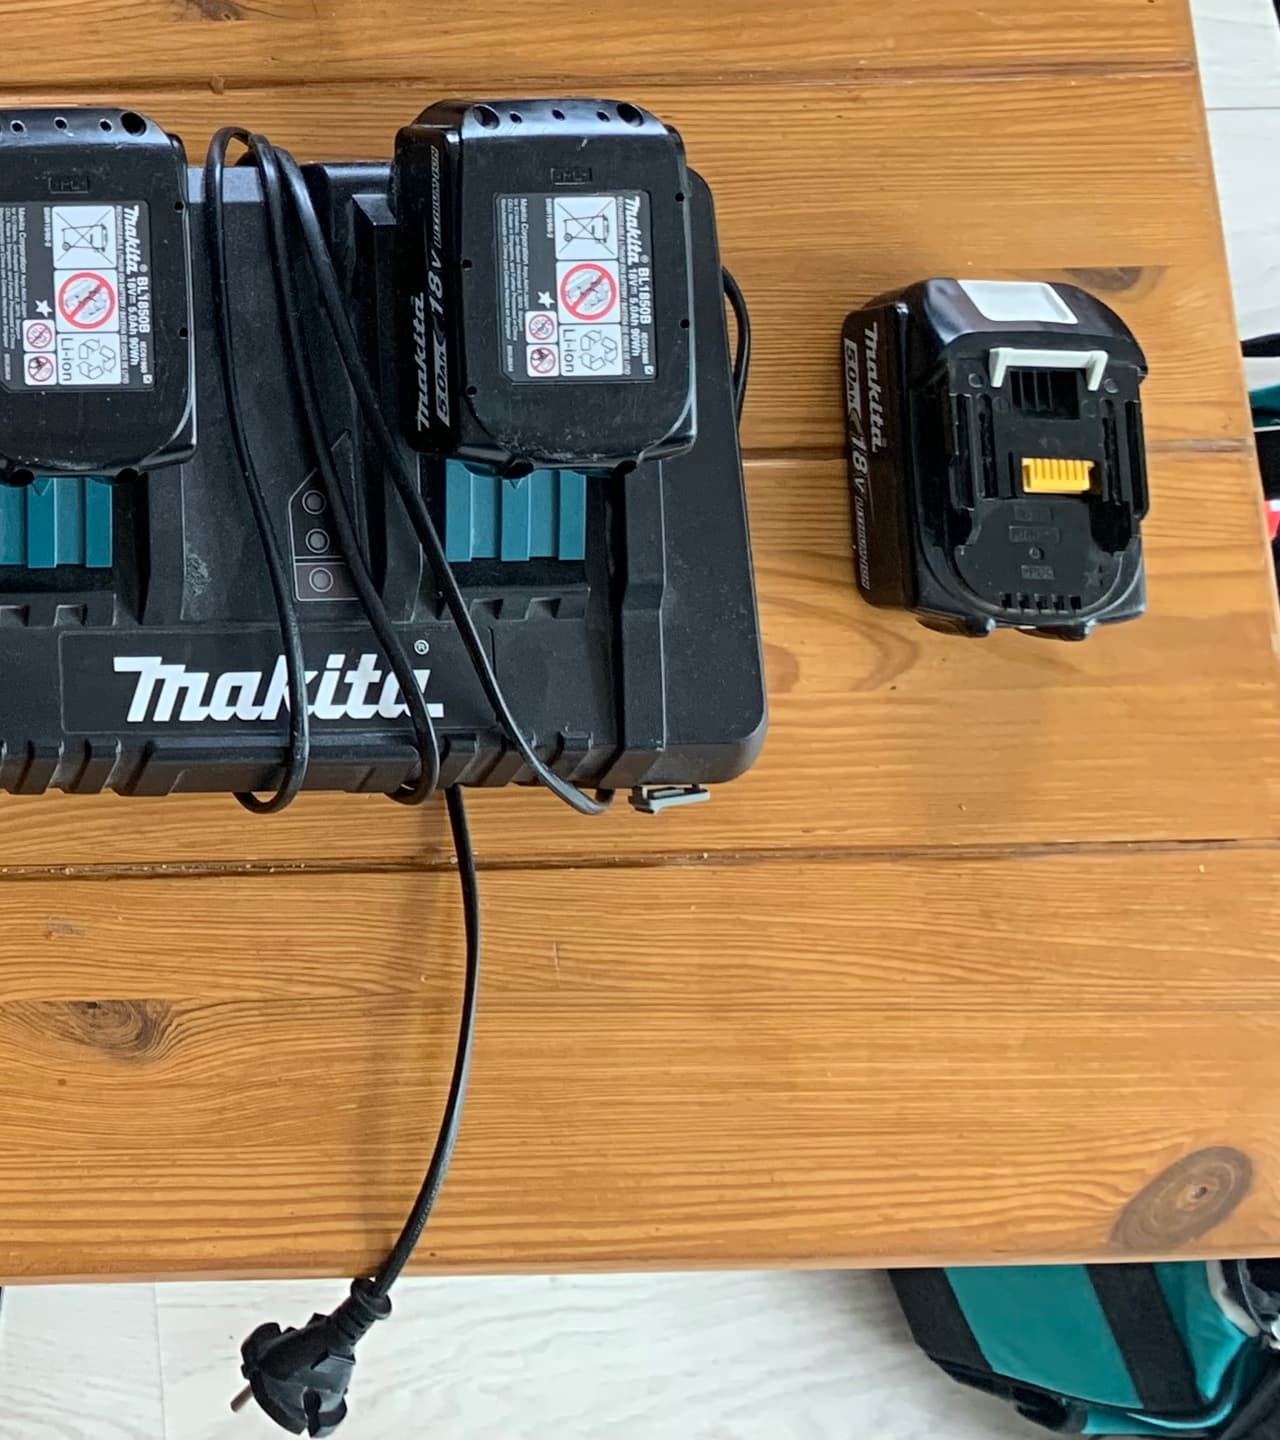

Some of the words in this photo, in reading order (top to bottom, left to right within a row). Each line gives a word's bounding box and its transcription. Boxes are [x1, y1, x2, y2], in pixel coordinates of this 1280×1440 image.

[126, 277, 136, 295] 18V
[628, 268, 637, 285] 18V
[136, 276, 150, 332] BL1850B
[637, 267, 651, 324] BL1850B
[127, 306, 137, 334] 5.0Ah
[629, 297, 638, 325] 5.0Ah
[128, 336, 139, 365] 90Wh
[562, 328, 577, 373] Li-ion
[630, 328, 640, 356] 90Wh
[60, 337, 74, 381] Li-ion
